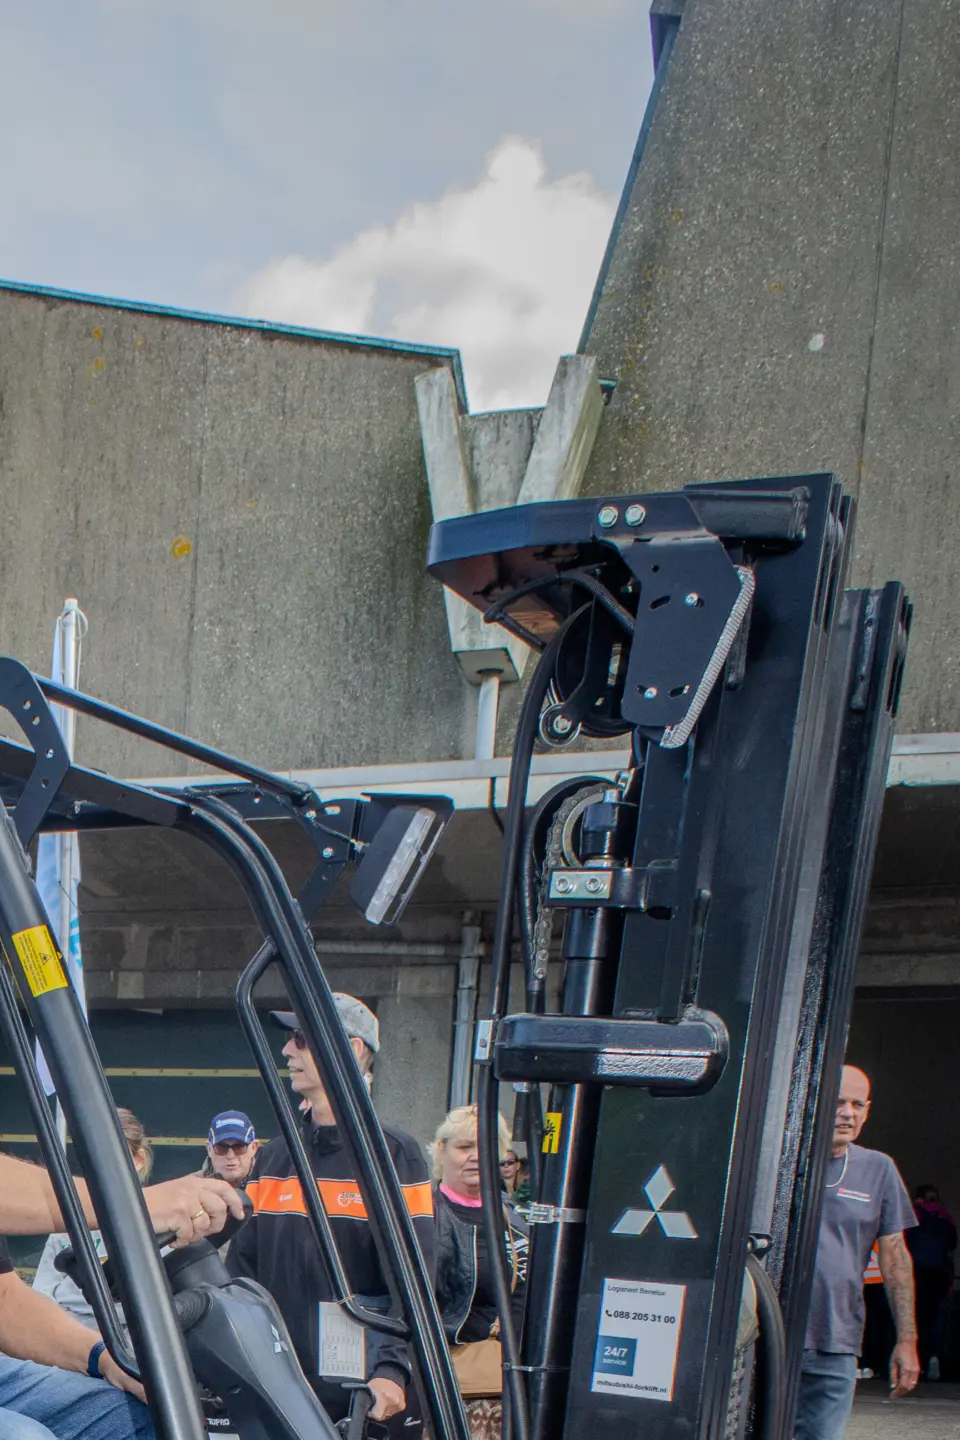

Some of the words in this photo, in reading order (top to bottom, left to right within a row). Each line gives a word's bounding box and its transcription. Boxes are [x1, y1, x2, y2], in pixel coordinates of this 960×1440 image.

[640, 1288, 666, 1296] Benelux
[613, 1310, 630, 1319] 088
[632, 1312, 649, 1321] 205
[650, 1314, 661, 1323] 31
[664, 1315, 676, 1324] 00
[603, 1346, 628, 1358] 24/7
[602, 1358, 627, 1366] service
[596, 1380, 667, 1393] mitsubishi-forklift.nl
